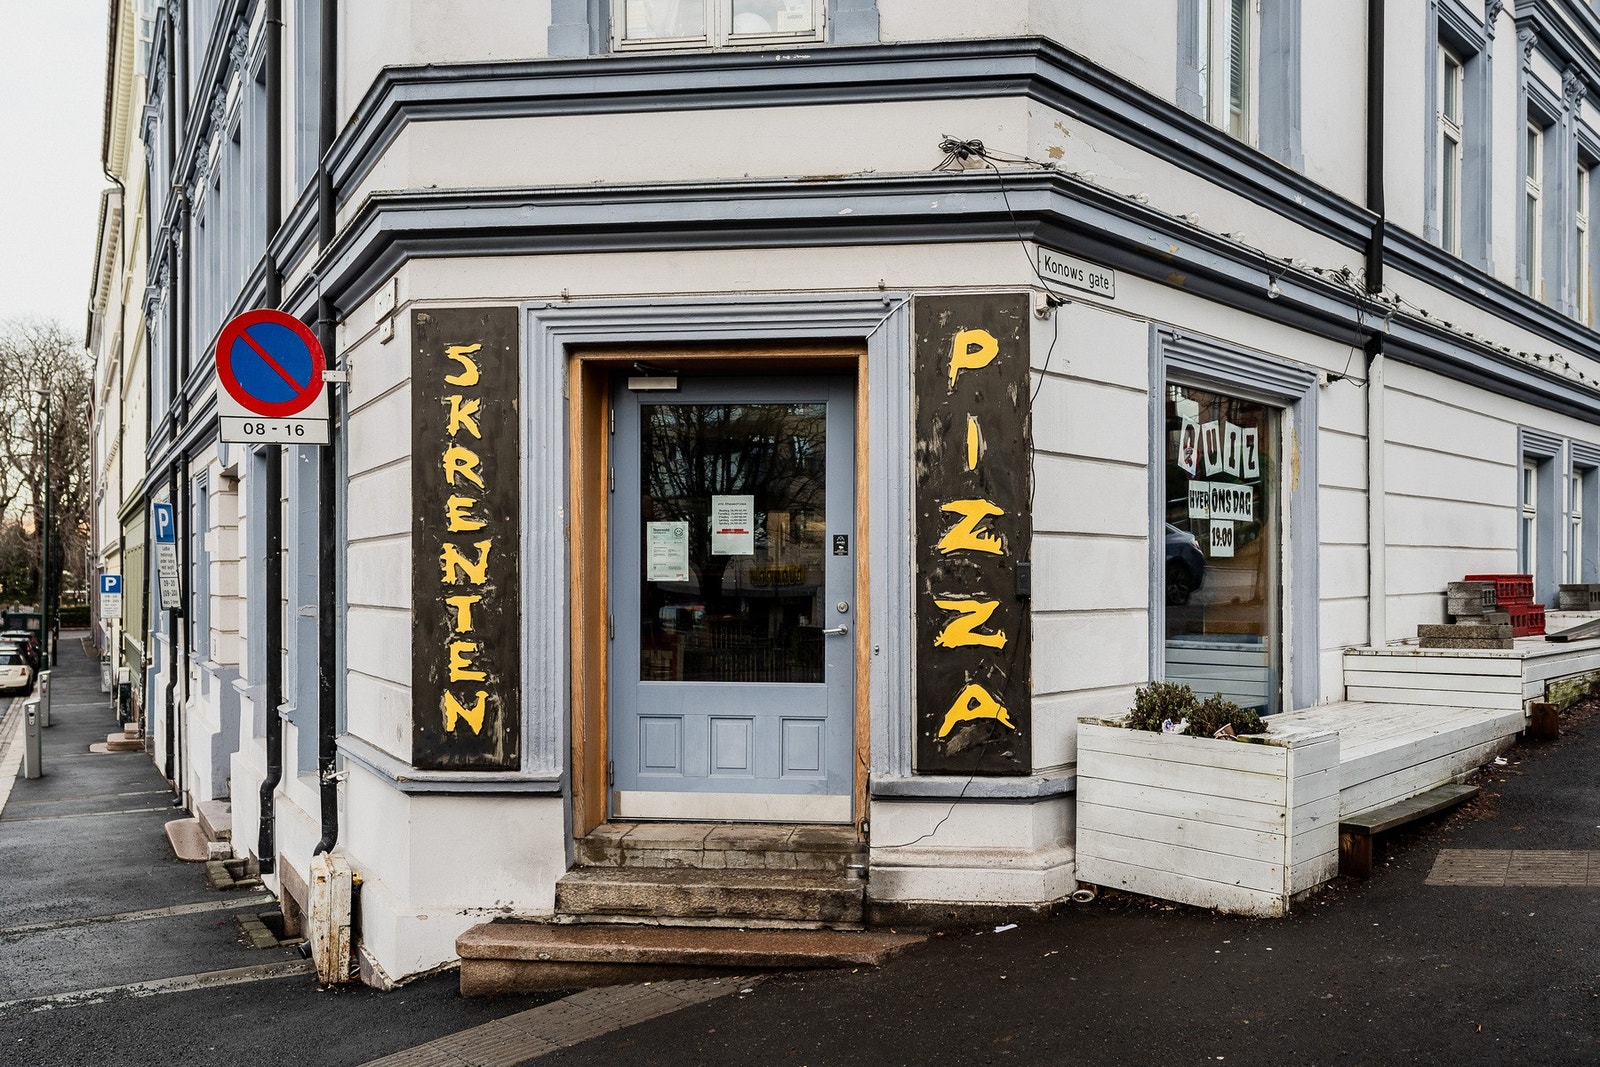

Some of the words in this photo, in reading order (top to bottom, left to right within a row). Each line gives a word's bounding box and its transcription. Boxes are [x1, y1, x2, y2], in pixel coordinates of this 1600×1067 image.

[1044, 254, 1084, 282] Konows
[1088, 271, 1109, 290] gate
[243, 422, 266, 435] 08
[284, 424, 305, 437] 16
[1182, 423, 1256, 470] QUIZ
[1189, 489, 1209, 509] HVER
[1211, 488, 1251, 516] ONSDAG
[158, 508, 169, 538] P
[439, 343, 492, 736] SKRENTEN
[934, 328, 1016, 739] PIZZA
[105, 577, 117, 591] P
